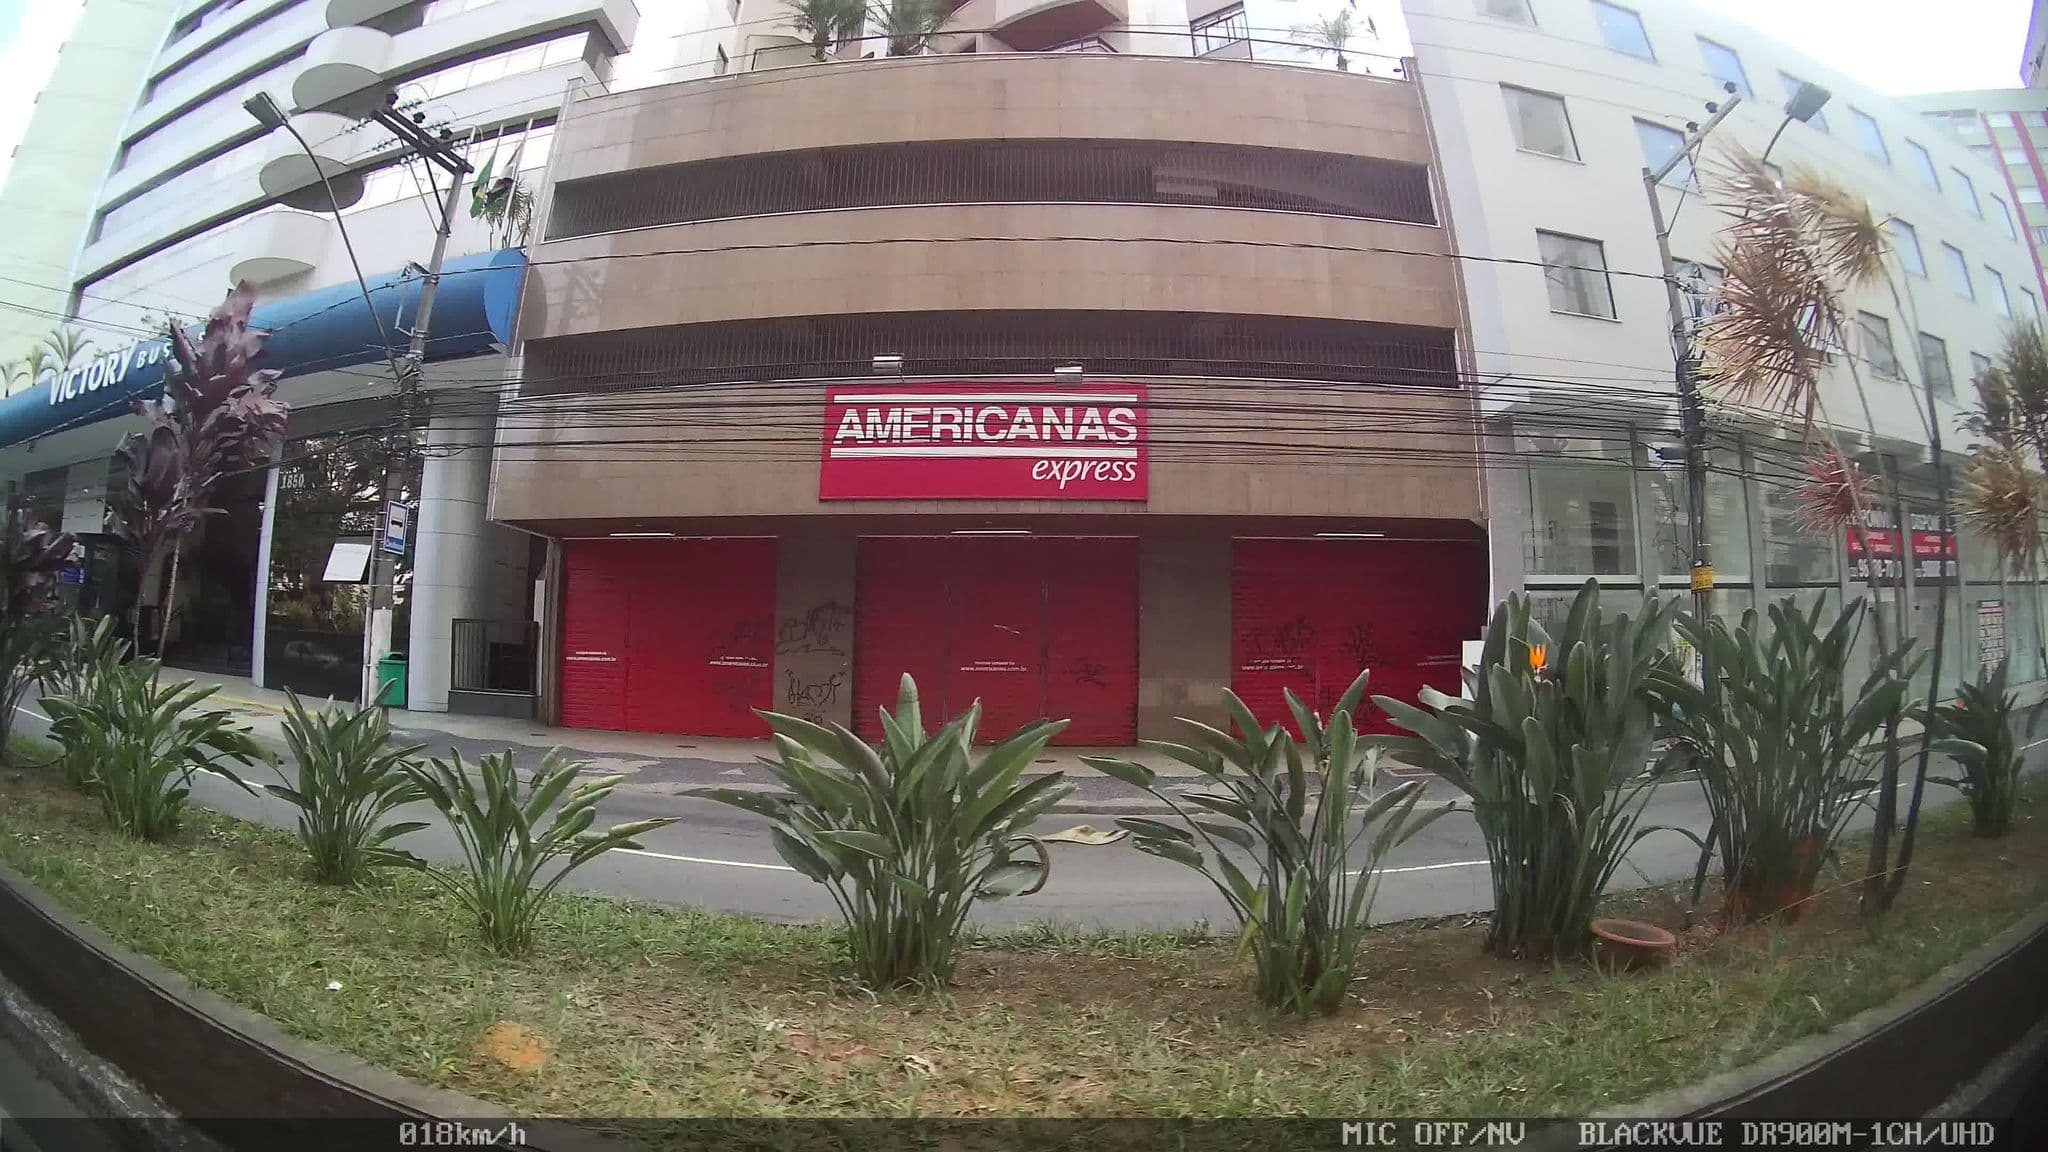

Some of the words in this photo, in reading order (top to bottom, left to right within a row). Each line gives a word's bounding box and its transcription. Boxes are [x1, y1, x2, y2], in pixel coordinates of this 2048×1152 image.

[50, 338, 138, 405] VICTORY
[833, 406, 1138, 445] AMERICANAS
[280, 474, 305, 489] 1850
[1031, 459, 1138, 489] express
